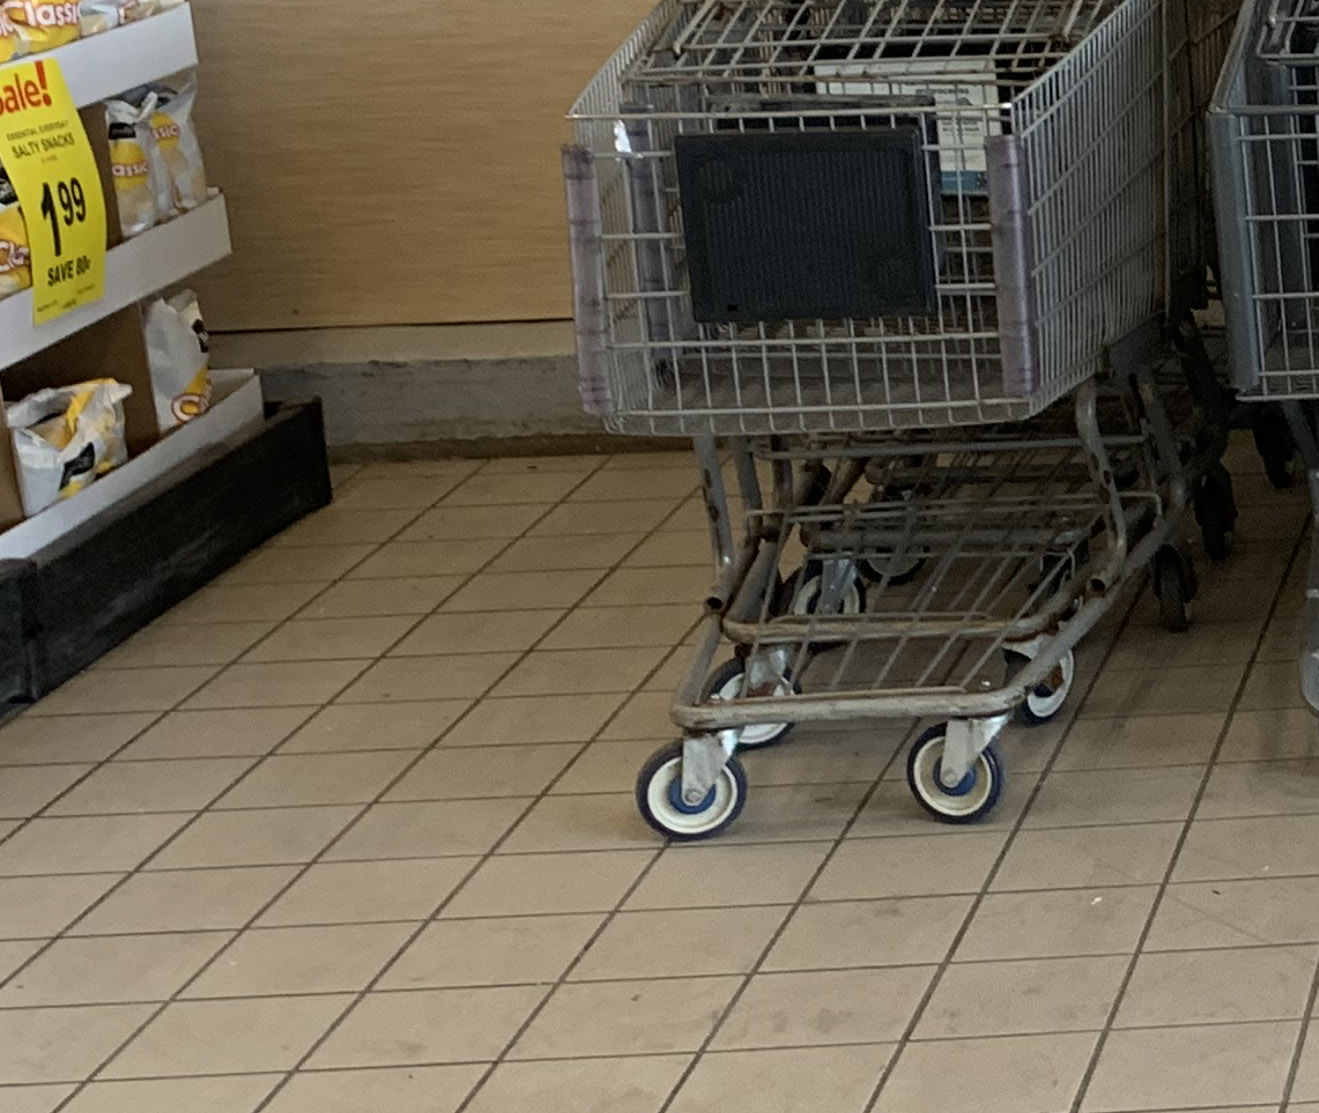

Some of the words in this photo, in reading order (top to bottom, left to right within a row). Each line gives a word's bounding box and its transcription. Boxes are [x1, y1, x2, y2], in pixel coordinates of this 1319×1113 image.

[11, 141, 40, 159] SALTY
[40, 132, 75, 152] SNACKS
[47, 260, 74, 287] SAVE
